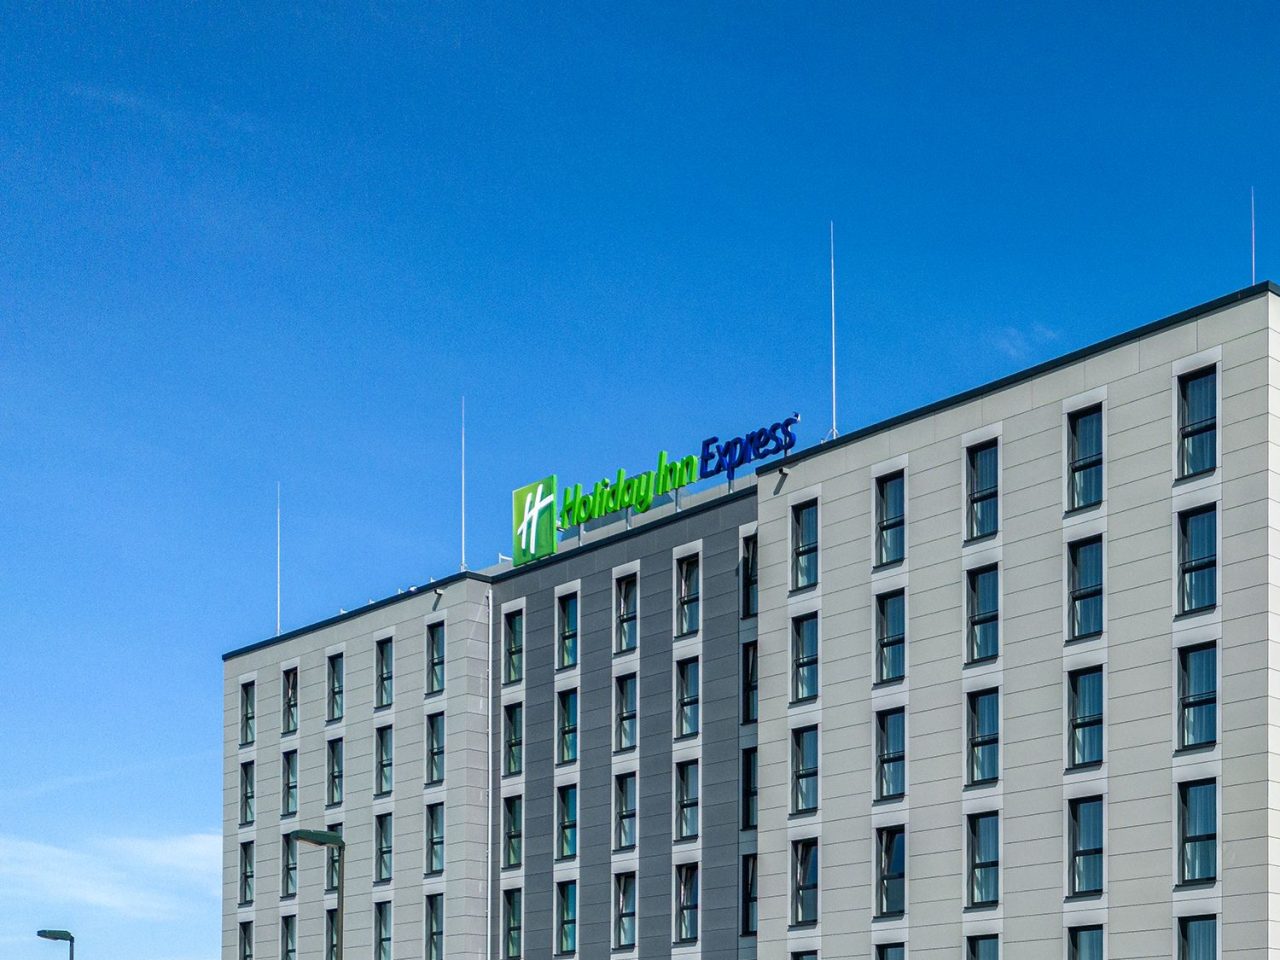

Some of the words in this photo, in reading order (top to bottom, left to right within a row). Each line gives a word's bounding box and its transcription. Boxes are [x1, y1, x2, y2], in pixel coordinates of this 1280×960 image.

[560, 467, 655, 529] Holiday
[656, 450, 698, 496] Inn
[700, 416, 798, 480] Express
